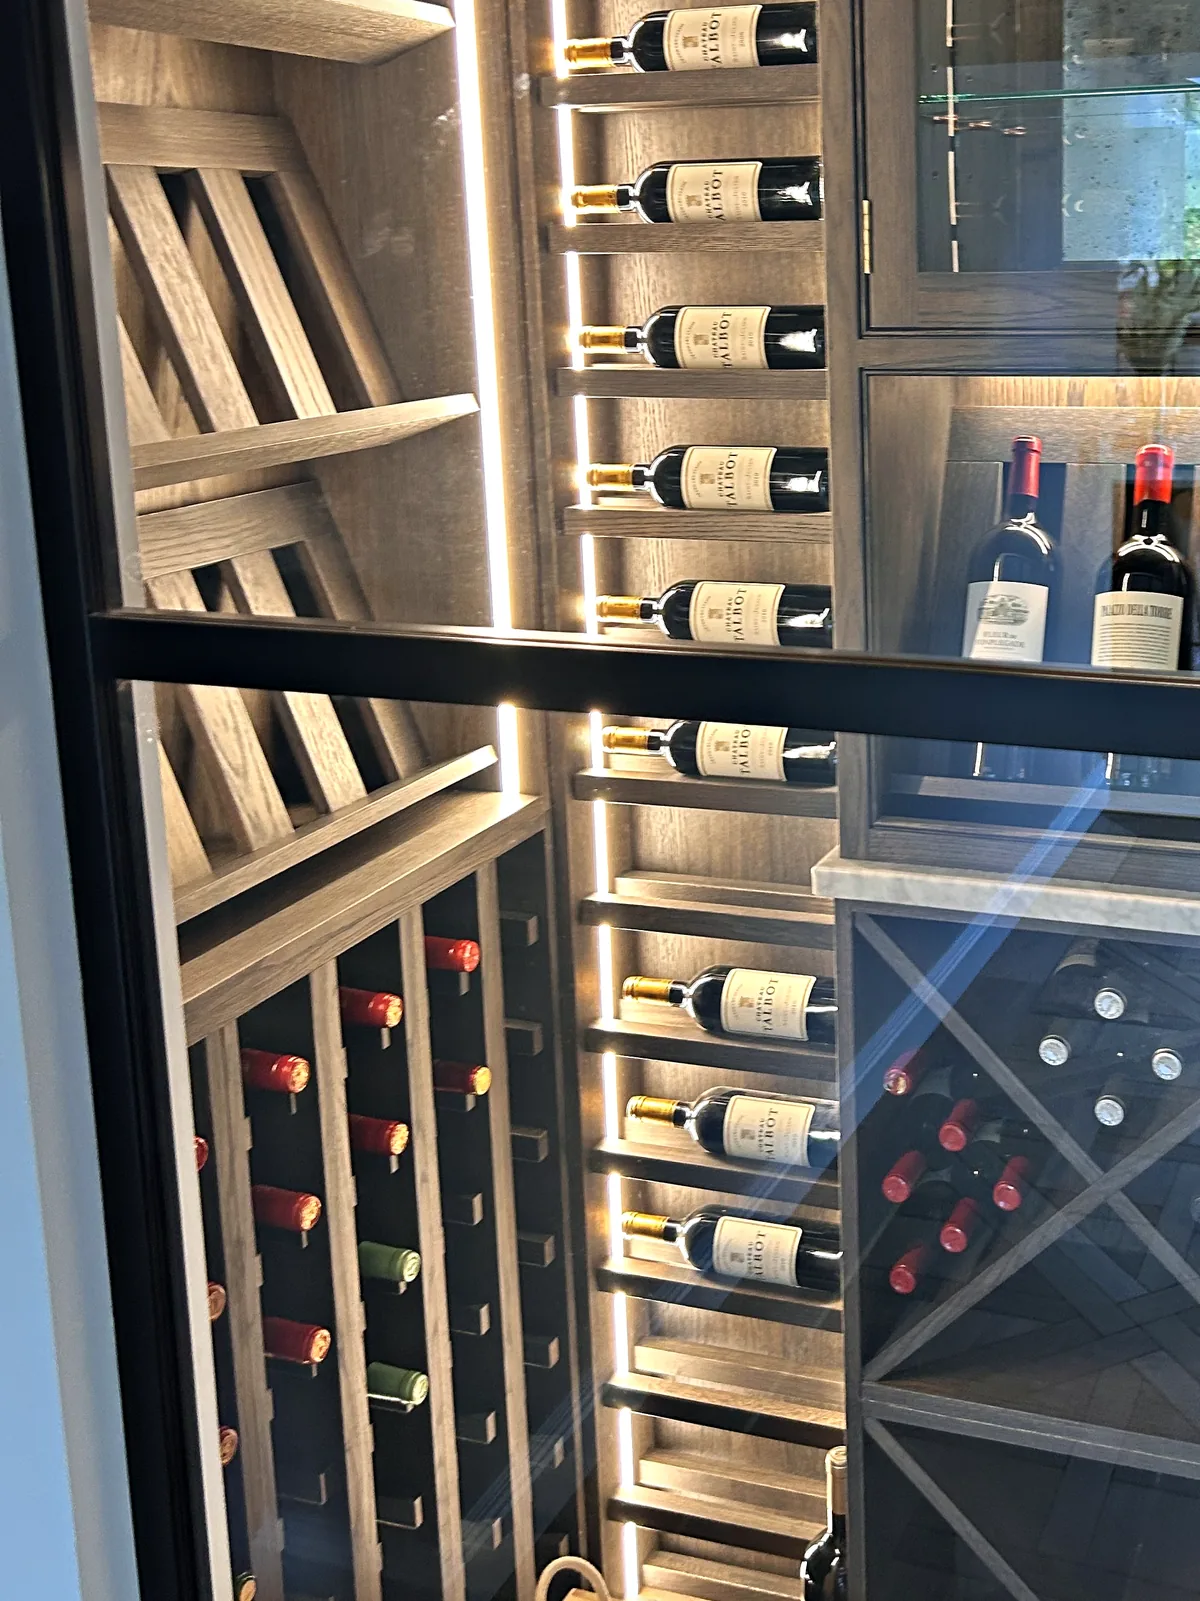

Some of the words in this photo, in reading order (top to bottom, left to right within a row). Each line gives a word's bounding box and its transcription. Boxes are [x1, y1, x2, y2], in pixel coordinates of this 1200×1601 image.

[719, 312, 734, 368] TALBOT
[724, 452, 739, 507] TALBOT
[733, 588, 748, 641] TALBOT
[739, 729, 752, 774] TALBO
[762, 979, 779, 1031] TALBOT
